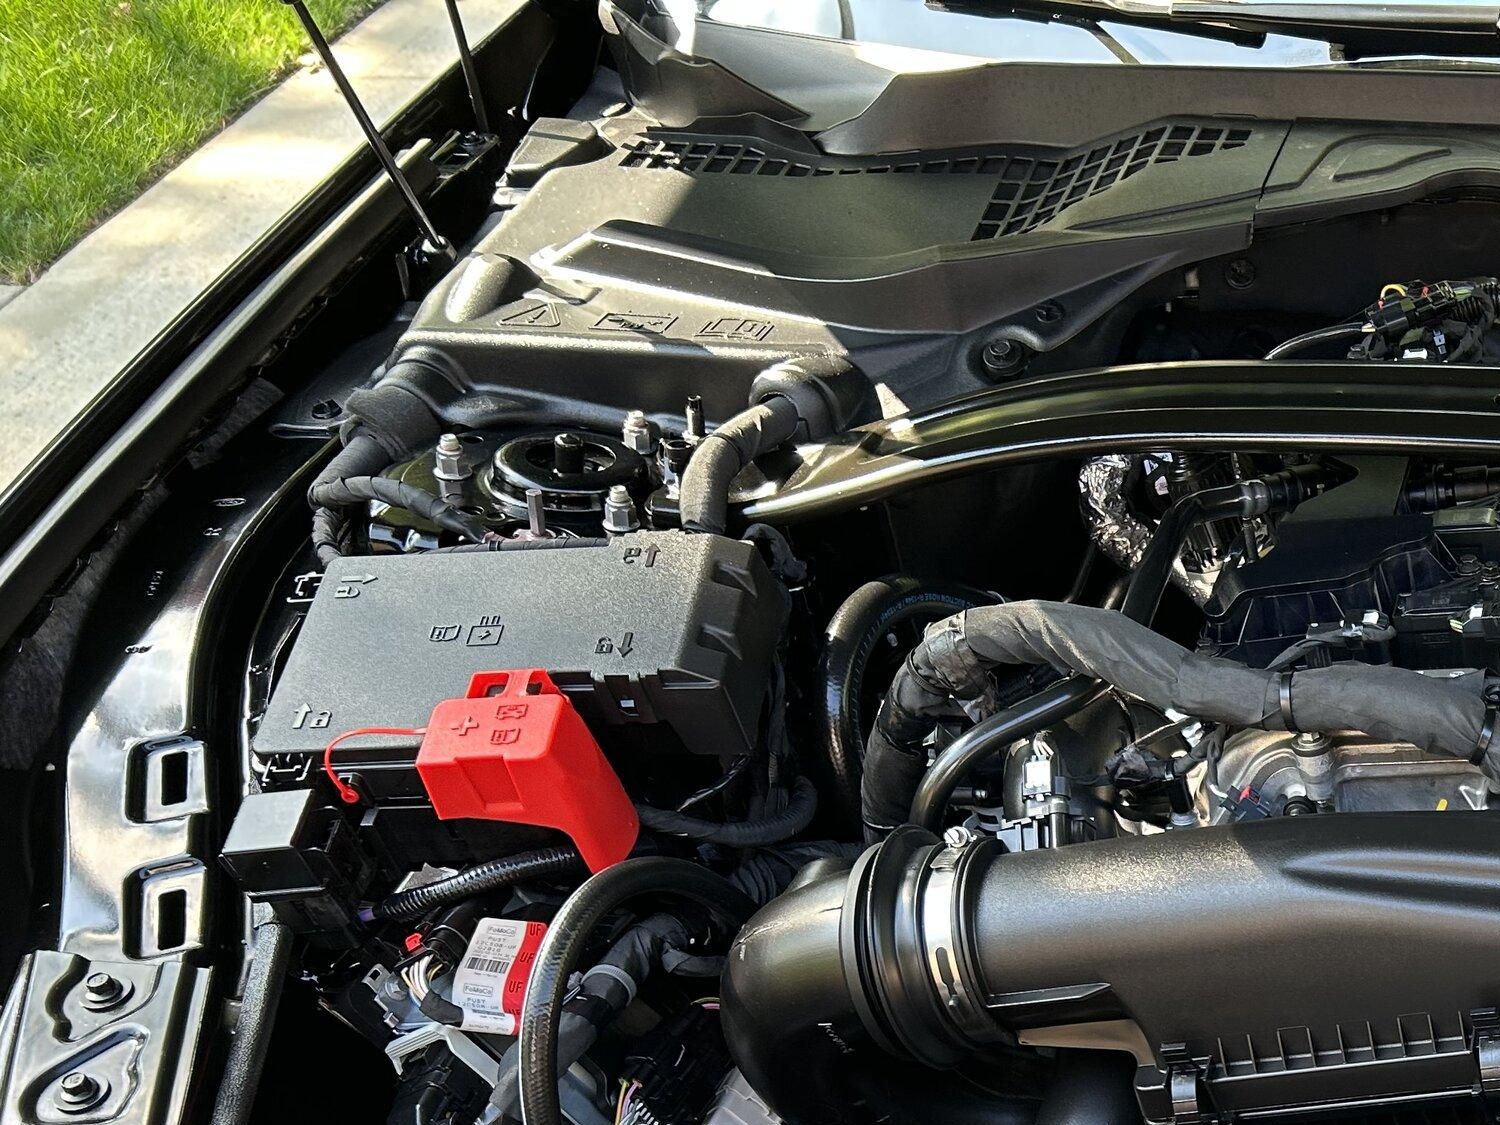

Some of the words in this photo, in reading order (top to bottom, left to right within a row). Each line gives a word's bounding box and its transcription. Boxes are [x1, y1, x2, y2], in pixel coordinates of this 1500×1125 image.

[529, 923, 542, 936] UF
[520, 952, 535, 963] UF
[508, 980, 524, 993] UF
